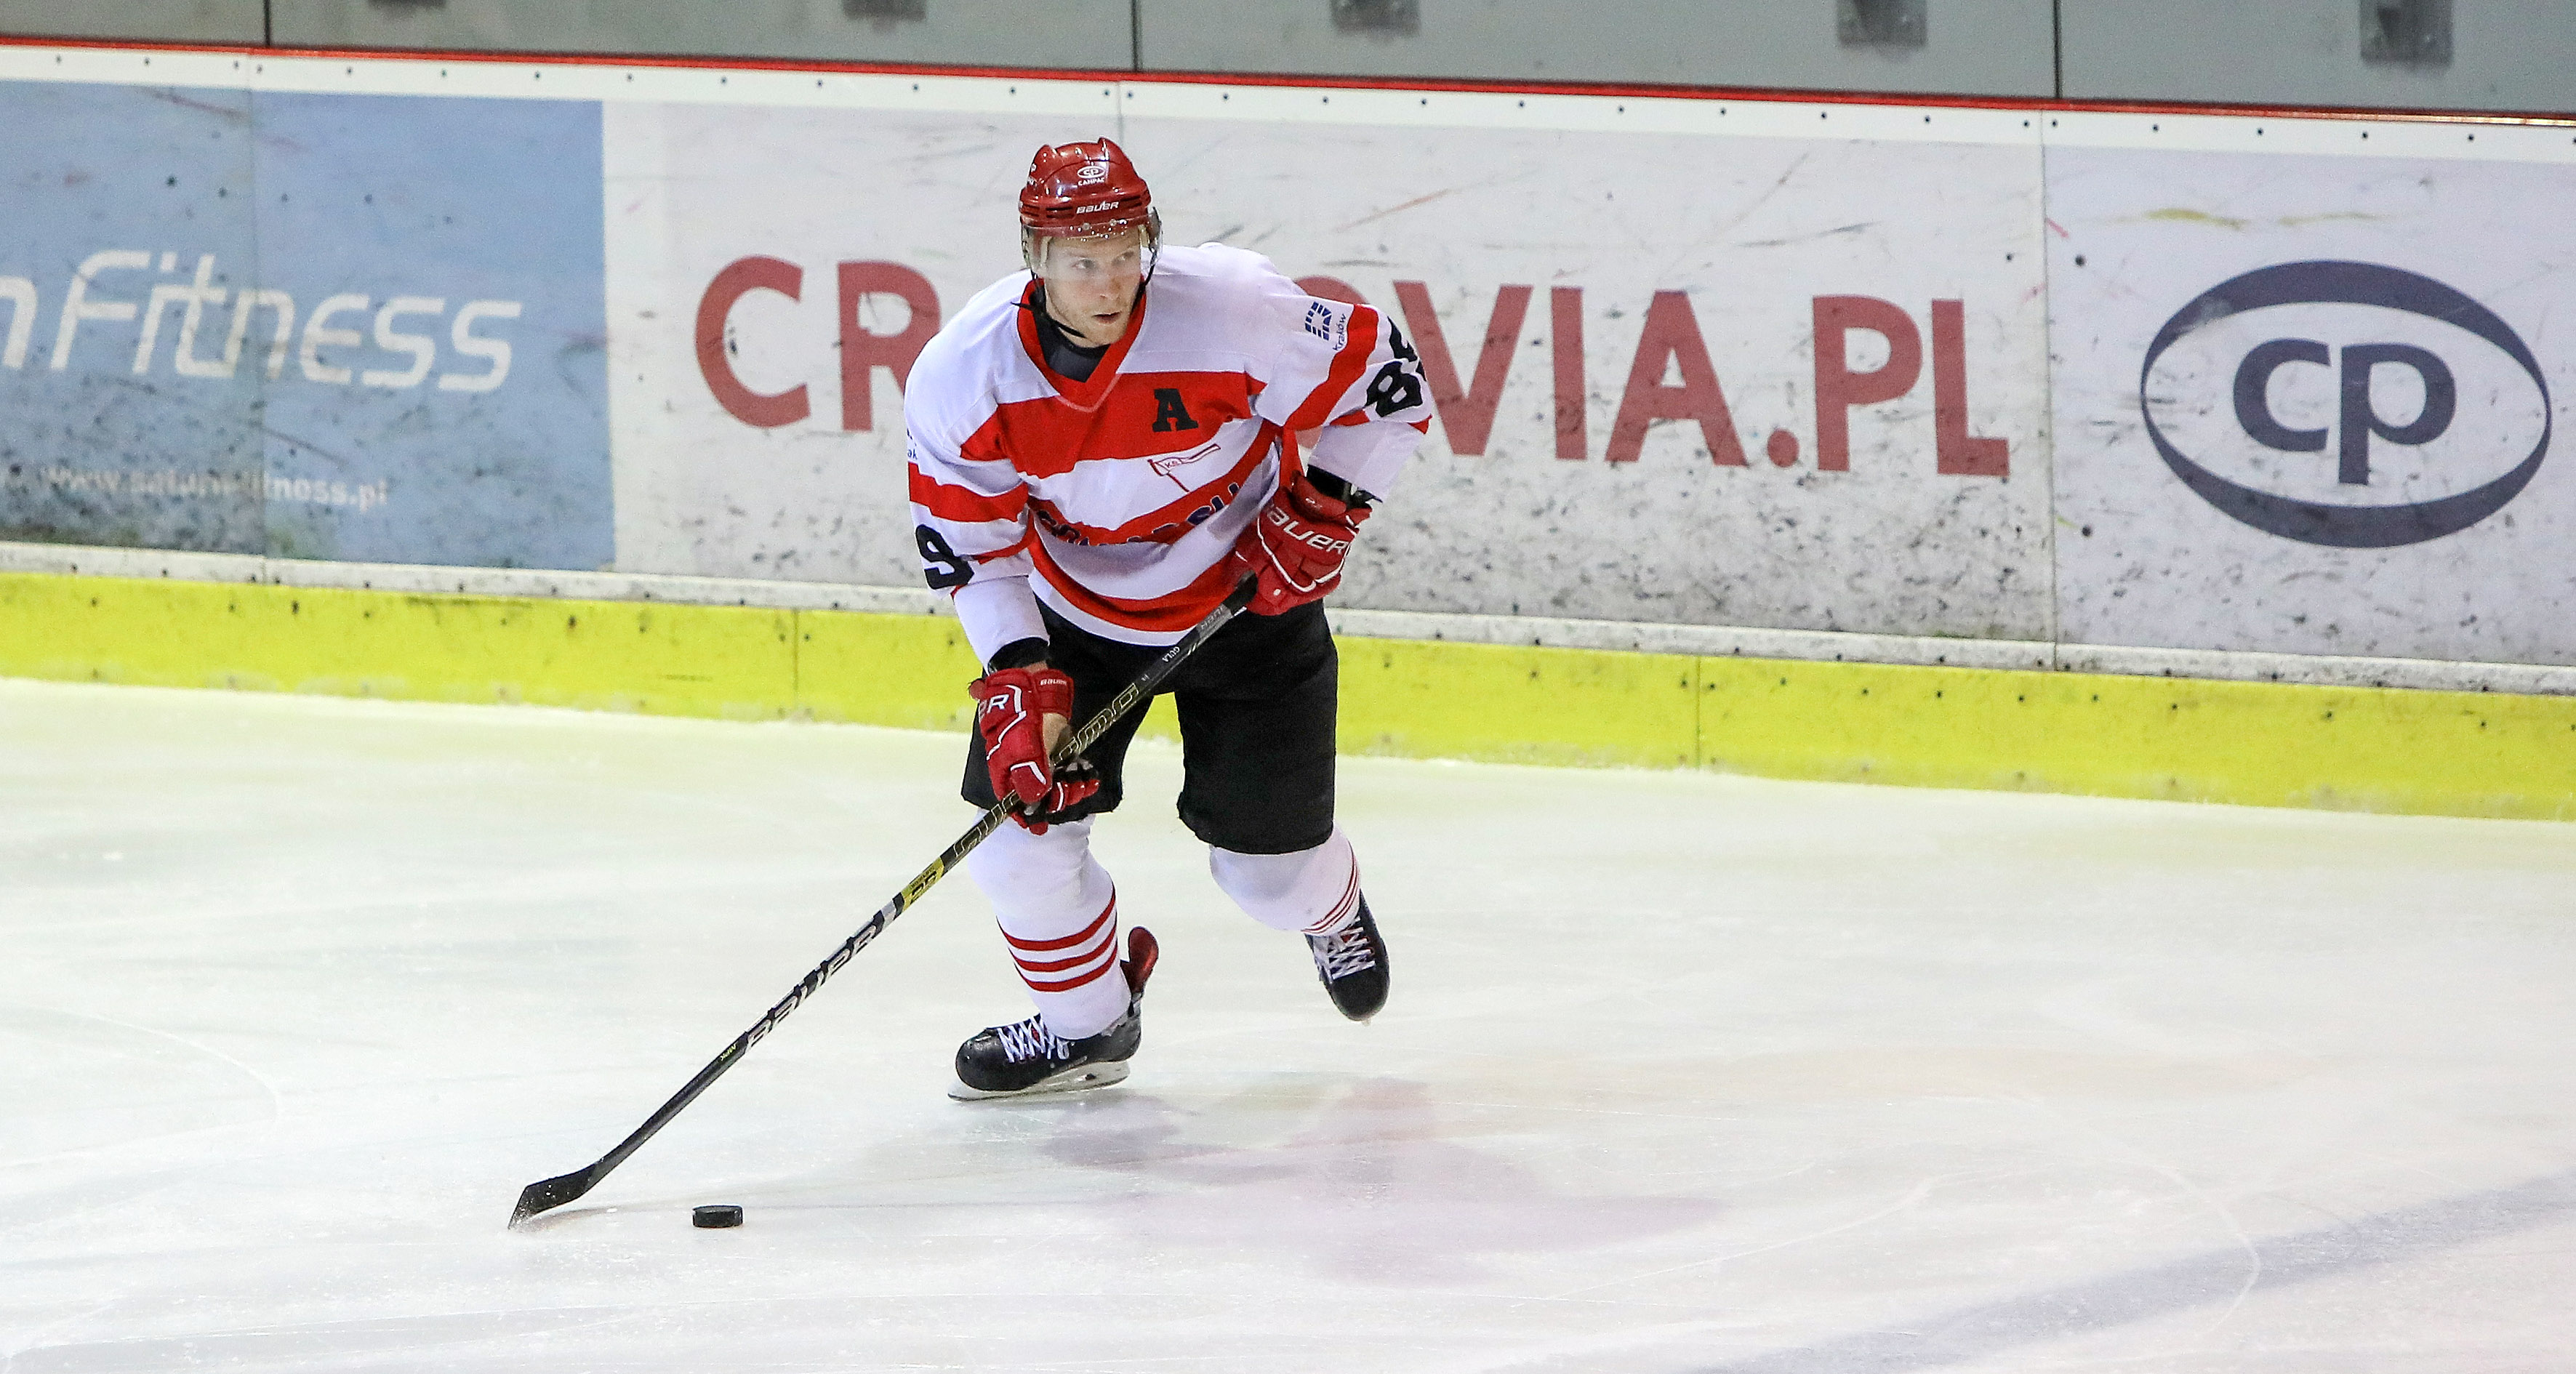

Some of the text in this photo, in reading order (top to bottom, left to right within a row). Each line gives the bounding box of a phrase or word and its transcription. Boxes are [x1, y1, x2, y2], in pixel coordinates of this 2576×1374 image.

[1076, 201, 1120, 214] BAUER
[50, 249, 522, 393] Fitness
[1152, 387, 1199, 433] A
[1267, 506, 1351, 555] AUER
[915, 523, 975, 590] 9
[1162, 646, 1181, 663] GULA
